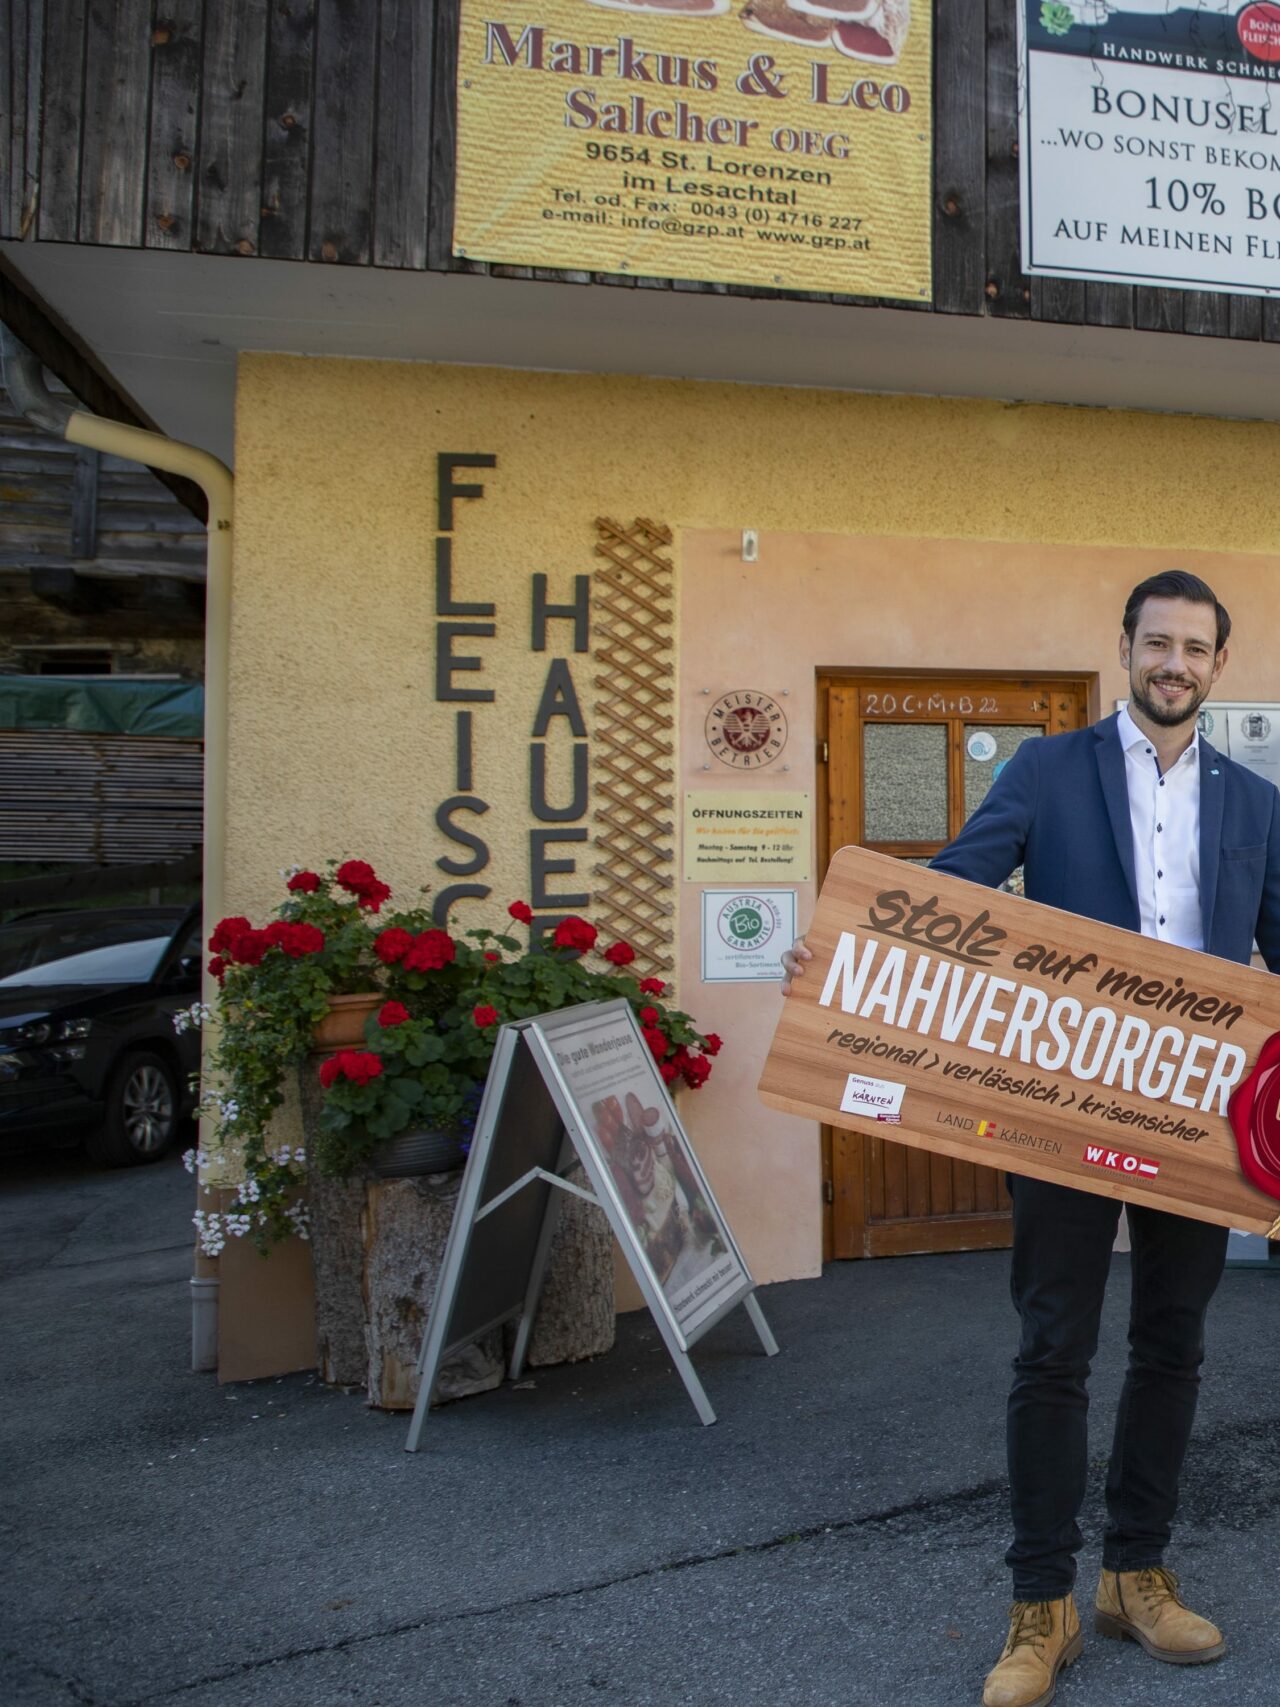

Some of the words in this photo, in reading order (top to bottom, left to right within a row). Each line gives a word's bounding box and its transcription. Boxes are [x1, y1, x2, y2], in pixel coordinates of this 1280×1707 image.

[481, 21, 717, 91] Markus
[735, 53, 788, 99] &
[810, 61, 911, 114] Leo
[1103, 42, 1208, 70] HANDWERK
[564, 87, 759, 148] Salcher
[770, 125, 851, 160] OEG
[586, 142, 650, 165] 9654
[661, 151, 695, 171] St.
[707, 155, 832, 185] Lorenzen
[1113, 136, 1195, 162] SONST
[623, 172, 655, 191] im
[666, 176, 797, 206] Lesachtal
[1145, 176, 1226, 217] 10%
[551, 188, 586, 204] Tel.
[594, 194, 625, 208] od.
[634, 197, 677, 213] Fax:
[691, 202, 737, 219] 0043
[745, 208, 770, 225] (0)
[777, 211, 823, 228] 4716
[829, 216, 862, 232] 227
[542, 208, 613, 226] e-mail:
[621, 213, 745, 239] info@gzp.at
[756, 228, 871, 251] www.gzp.at
[1054, 219, 1109, 243] AUF
[1120, 226, 1233, 255] MEINEN
[713, 694, 780, 721] MEISTER
[866, 694, 897, 714] 20
[711, 738, 781, 766] BETRIEB
[692, 808, 803, 819] ÖFFNUNGSZEITEN
[729, 844, 757, 852] Samstag
[722, 899, 762, 920] AUSTRIA
[727, 926, 771, 948] GARANTIE
[1012, 941, 1098, 984] auf
[1097, 966, 1245, 1030] meinen
[818, 931, 1247, 1118] NAHVERSORGER
[826, 1027, 923, 1071] regional
[942, 1058, 1062, 1108] verlässlich
[1078, 1092, 1209, 1143] krisensicher
[936, 1111, 974, 1132] LAND
[1000, 1128, 1063, 1155] KÄRNTEN
[1086, 1145, 1138, 1171] WKO
